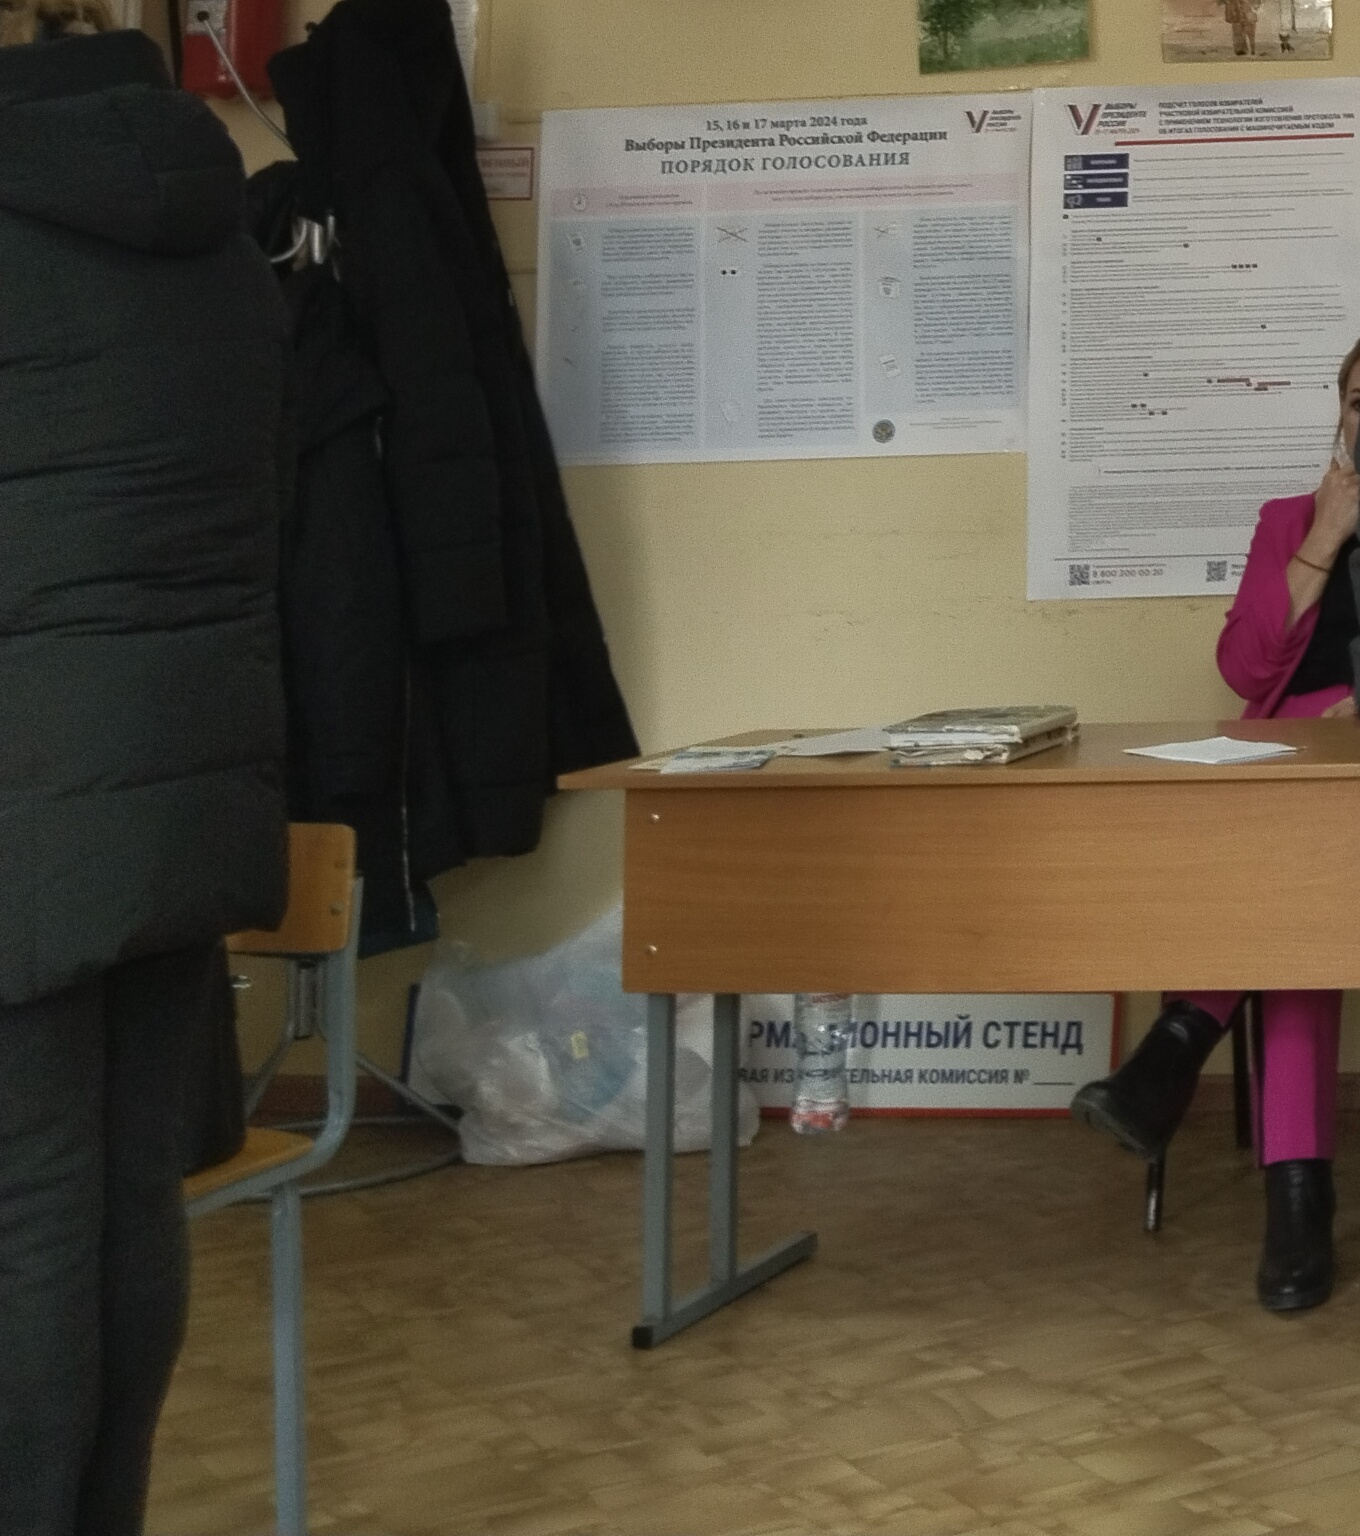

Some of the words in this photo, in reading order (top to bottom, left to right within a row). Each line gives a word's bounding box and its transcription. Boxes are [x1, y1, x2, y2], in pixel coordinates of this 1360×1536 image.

[770, 119, 807, 131] марта
[809, 116, 838, 128] 2024
[624, 137, 686, 154] Выборы
[688, 136, 775, 152] Президента
[779, 132, 863, 147] Российской
[867, 130, 948, 145] Федерации
[660, 157, 755, 175] ПОРЯДОК
[761, 152, 910, 171] ГОЛОСОВАНИЯ
[983, 1020, 1084, 1056] СТЕНД
[918, 1068, 1009, 1085] КОМИССИЯ
